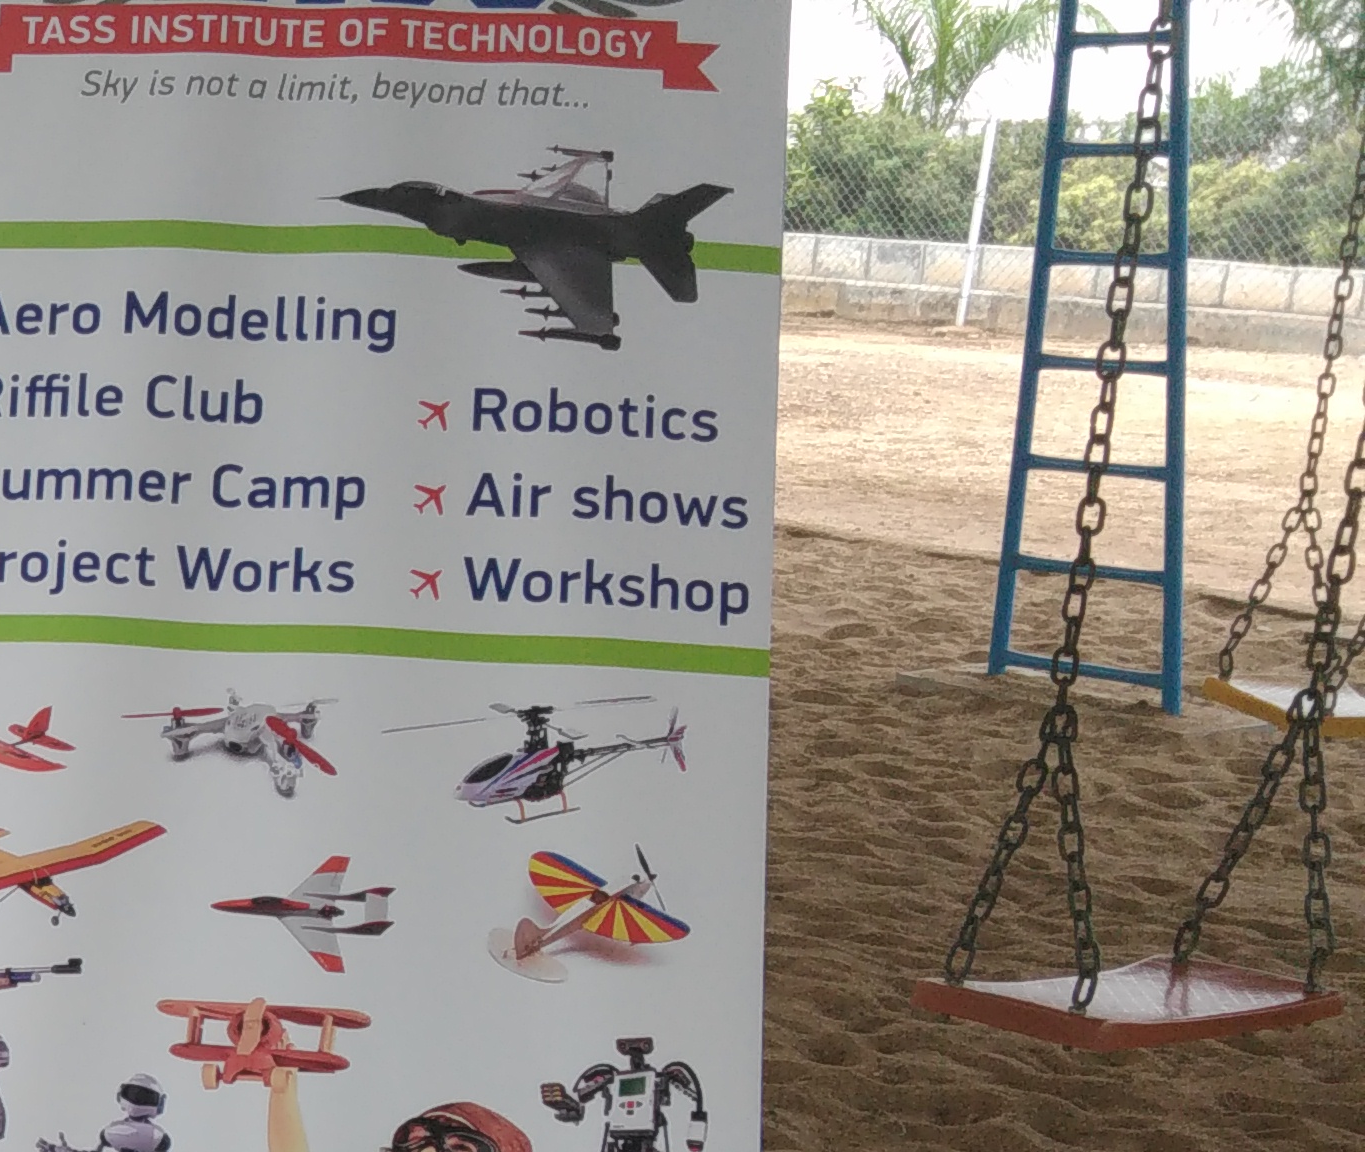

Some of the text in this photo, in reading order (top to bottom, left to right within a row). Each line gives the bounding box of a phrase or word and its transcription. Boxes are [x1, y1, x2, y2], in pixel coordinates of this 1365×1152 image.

[22, 14, 652, 59] TASS INSTITUTE OF TECHNOLOGY
[80, 69, 589, 109] Sky is not a limit, beyond that...
[124, 290, 397, 354] Modelling
[146, 374, 263, 425] Club
[472, 387, 719, 443] Robotics
[212, 463, 366, 521] Camp
[465, 472, 749, 530] Air shows
[176, 545, 355, 593] Works
[463, 556, 750, 627] Workshop
